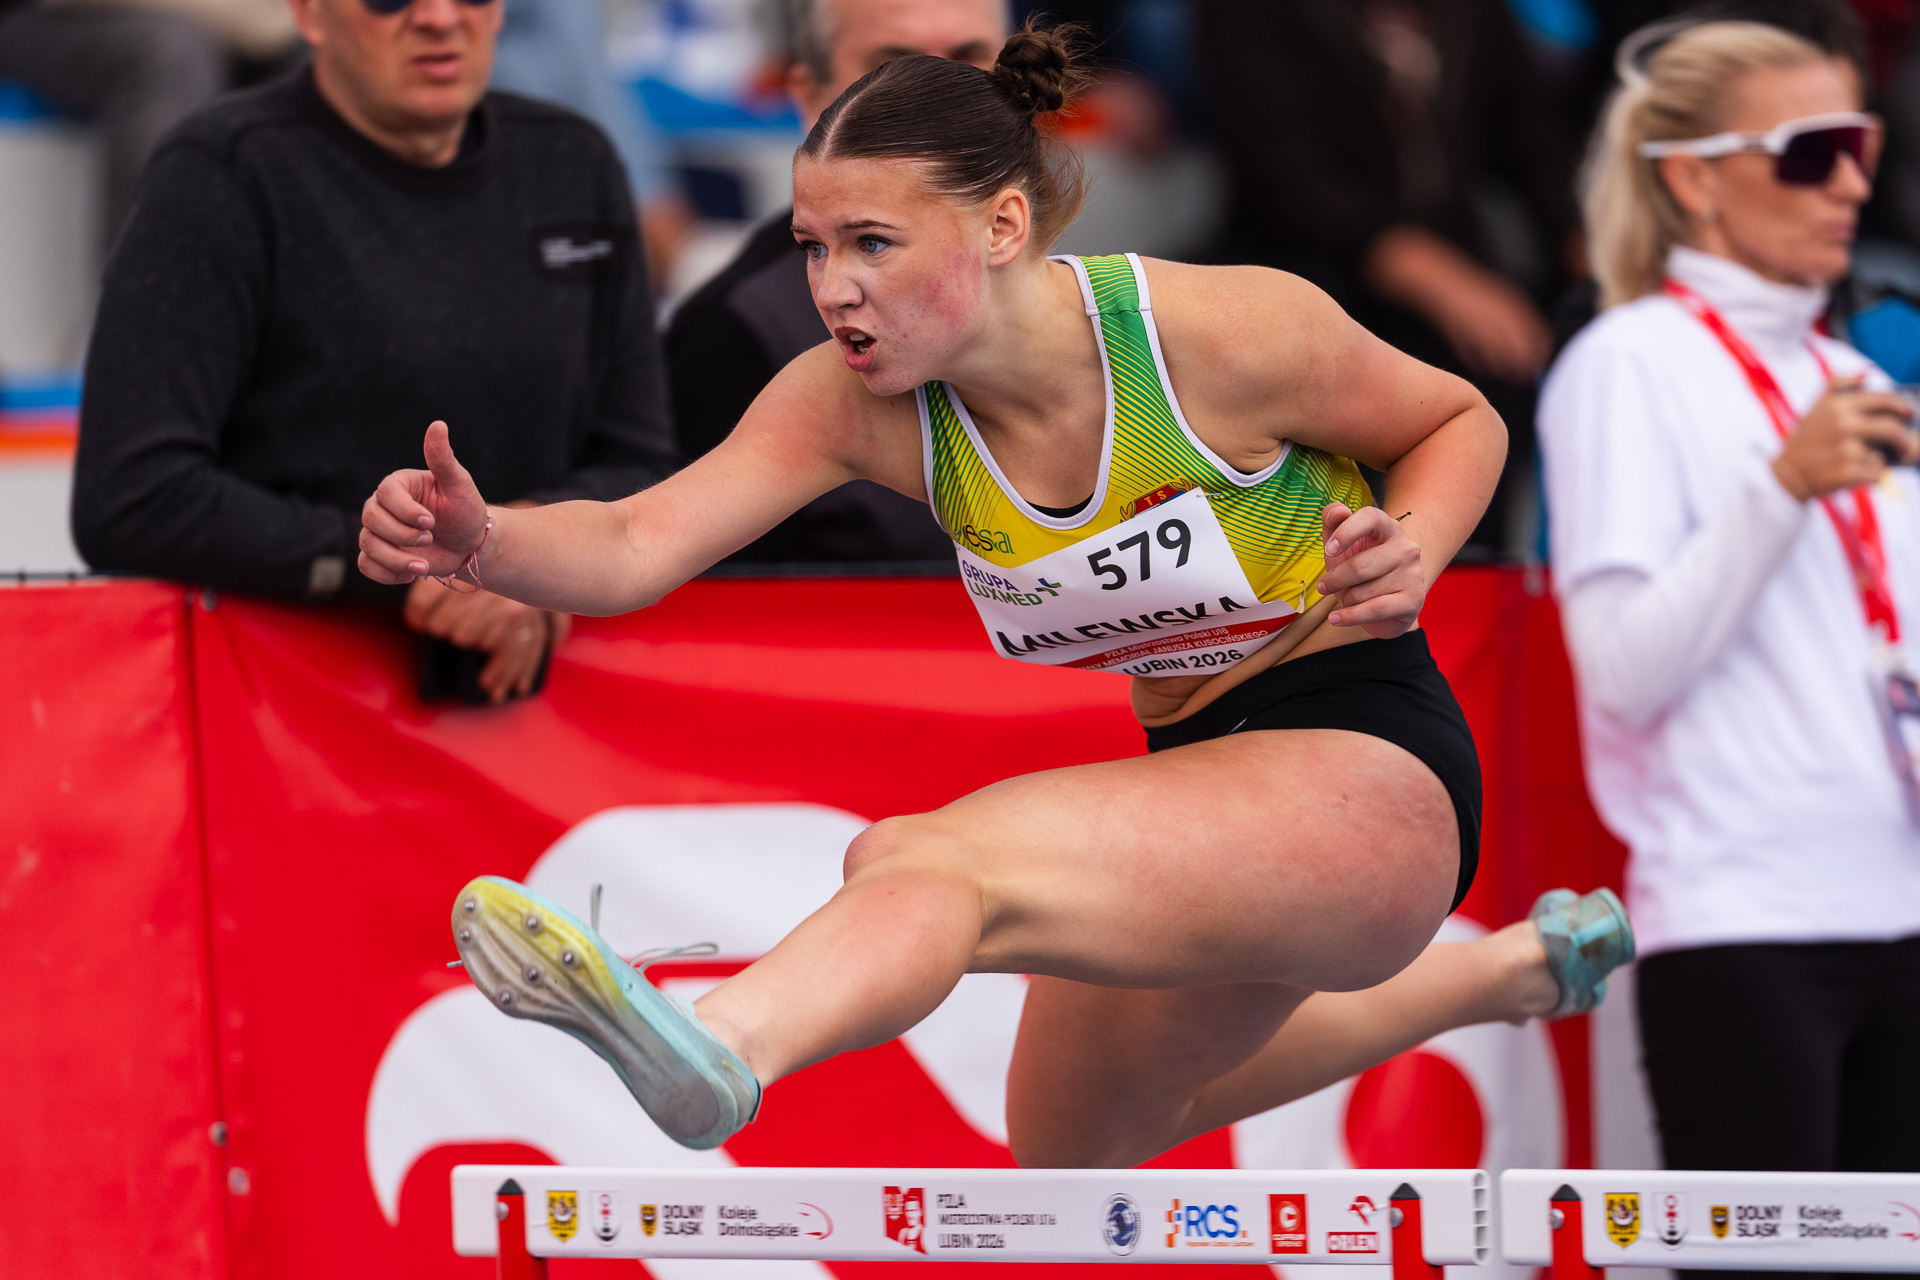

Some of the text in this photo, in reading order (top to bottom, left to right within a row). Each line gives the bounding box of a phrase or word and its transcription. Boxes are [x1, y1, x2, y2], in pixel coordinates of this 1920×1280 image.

[1087, 518, 1192, 591] 579
[962, 559, 1020, 592] GRUPA
[966, 578, 1043, 606] LUXMED
[996, 595, 1252, 656] MILEWSKA
[1104, 627, 1229, 659] PZLA Mistrzostwa Polski U16
[1151, 641, 1194, 655] JANUSZA
[1194, 629, 1269, 648] KUSOCIŃSKIEGO
[1122, 649, 1245, 676] LUBIN 2026
[662, 1204, 706, 1220] DOLNY
[717, 1205, 758, 1223] Koleje
[1735, 1205, 1783, 1221] DOLNY
[1328, 1234, 1378, 1251] ORLEN
